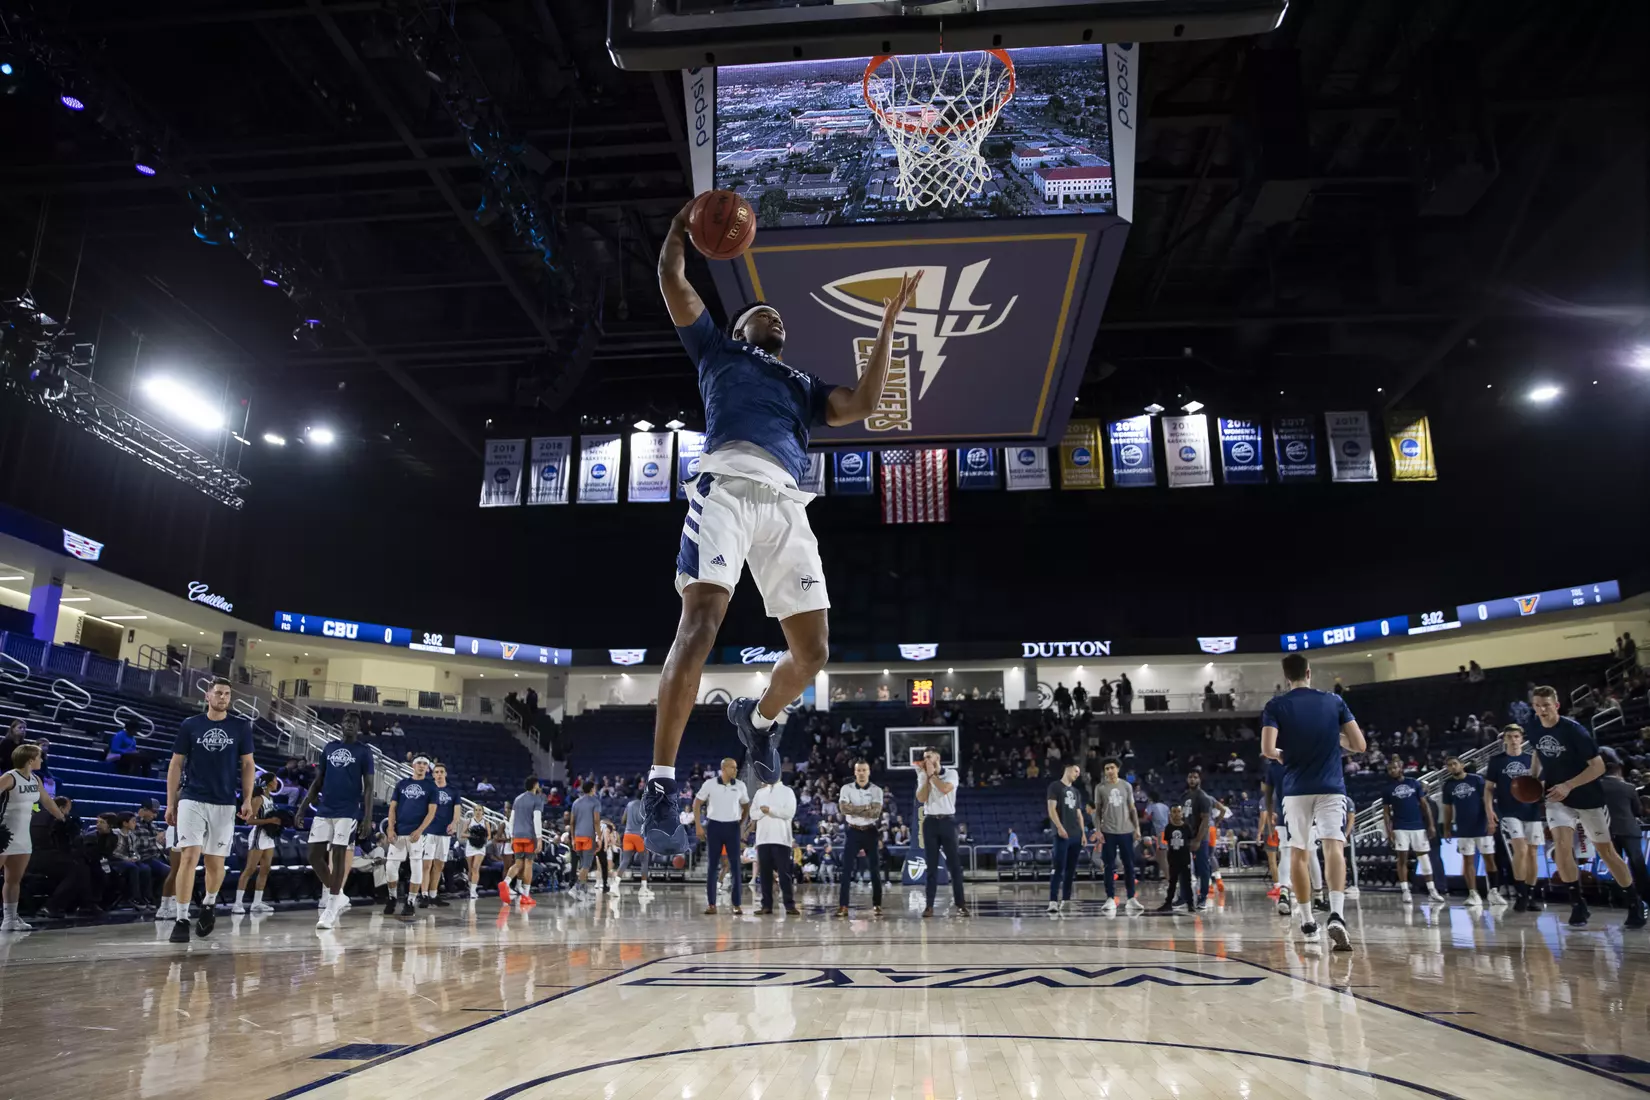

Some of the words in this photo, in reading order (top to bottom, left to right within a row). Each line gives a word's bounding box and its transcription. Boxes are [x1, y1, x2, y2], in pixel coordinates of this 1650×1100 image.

[1114, 51, 1133, 129] pepsi
[690, 77, 710, 147] pepsi
[188, 581, 233, 612] Cadillac
[1421, 611, 1445, 625] 3:02
[1478, 605, 1488, 620] 0
[322, 620, 358, 639] CBU
[384, 628, 392, 643] 0
[423, 632, 443, 646] 3:02
[1323, 626, 1356, 645] CBU
[1381, 620, 1389, 636] 0
[471, 640, 478, 654] 0
[1022, 640, 1111, 658] DUTTON
[912, 690, 930, 704] 30
[327, 755, 356, 763] LANCERS
[617, 966, 1268, 988] WAC
